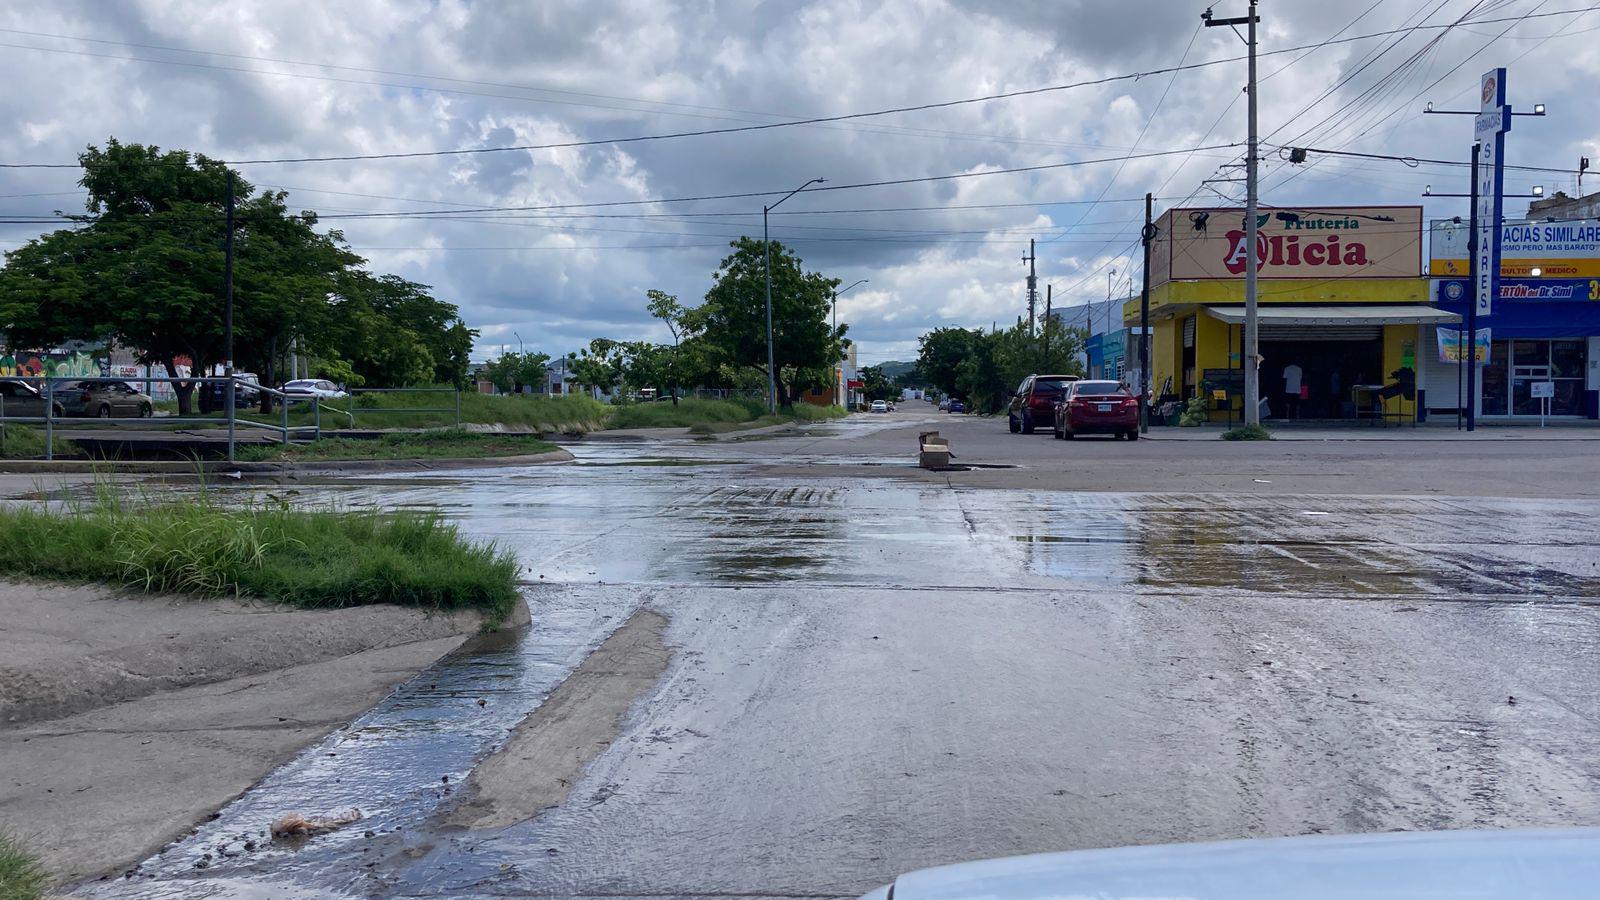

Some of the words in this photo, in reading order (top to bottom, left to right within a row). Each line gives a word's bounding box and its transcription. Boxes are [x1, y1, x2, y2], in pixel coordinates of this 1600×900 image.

[1477, 113, 1501, 133] FARMACIAS
[1284, 217, 1359, 230] Frutería
[1481, 143, 1492, 309] SIMILARES
[1226, 232, 1368, 266] Alicia
[1551, 285, 1571, 297] Simi
